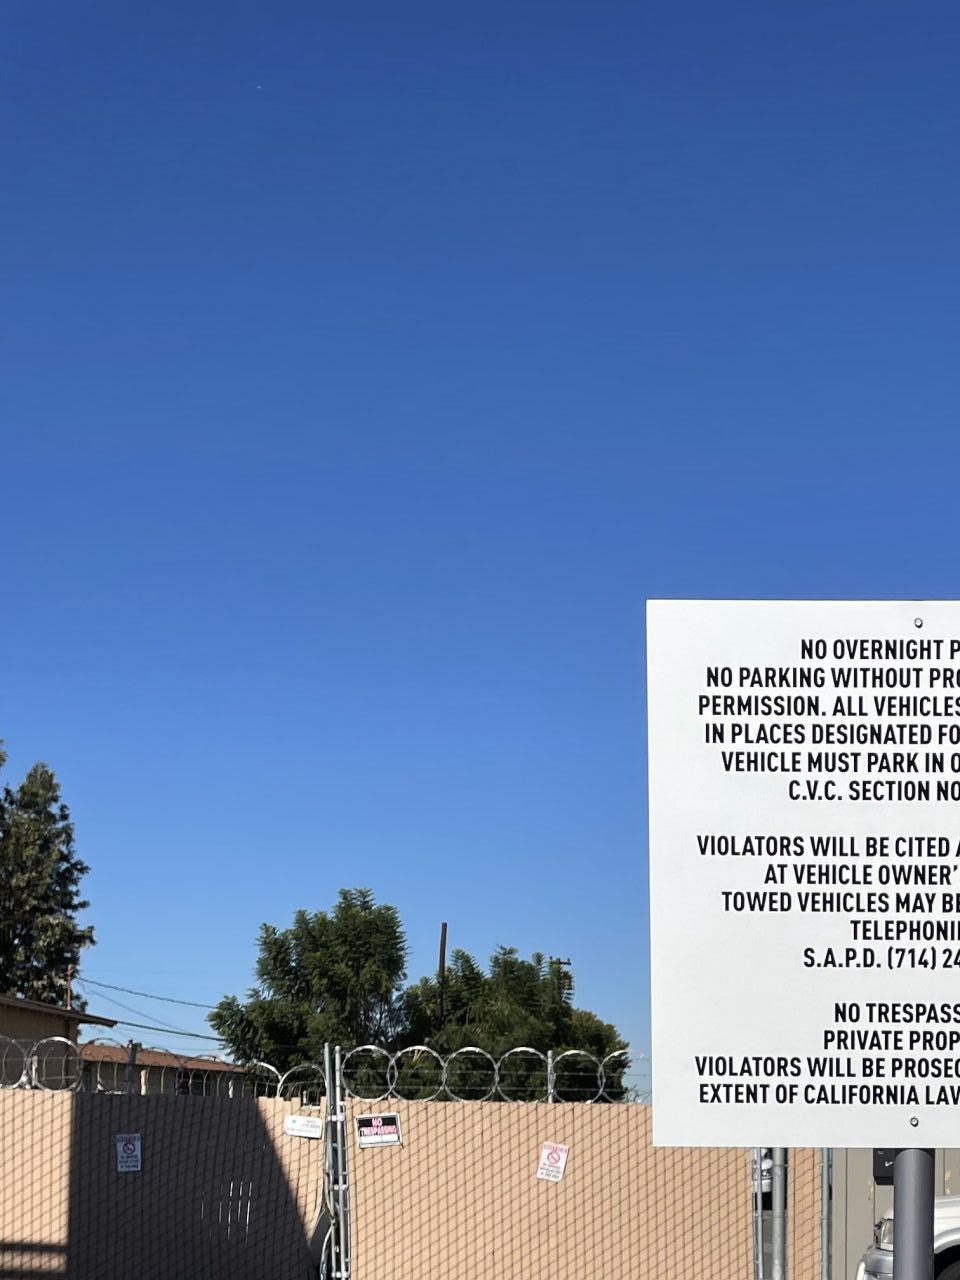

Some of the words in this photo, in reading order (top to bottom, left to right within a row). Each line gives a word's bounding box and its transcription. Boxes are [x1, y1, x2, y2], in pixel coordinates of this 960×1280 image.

[801, 638, 828, 660] NO
[832, 638, 944, 660] OVERNIGHT
[706, 666, 733, 688] NO
[739, 666, 826, 689] PARKING
[830, 667, 924, 689] WITHOUT
[698, 694, 827, 717] PERMISSION.
[832, 695, 869, 717] ALL
[705, 722, 725, 744] IN
[731, 722, 806, 745] PLACES
[811, 723, 932, 745] DESIGNATED
[721, 751, 802, 773] VEHICLE
[807, 751, 862, 773] MUST
[867, 752, 919, 773] PARK
[925, 752, 945, 773] IN
[788, 779, 843, 801] C.V.C.
[848, 780, 930, 802] SECTION
[696, 835, 805, 857] VIOLATORS
[809, 836, 860, 857] WILL
[865, 836, 890, 857] BE
[894, 836, 950, 858] CITED
[763, 863, 788, 885] AT
[792, 863, 873, 885] VEHICLE
[721, 891, 792, 912] TOWED
[796, 891, 890, 913] VEHICLES
[895, 892, 937, 914] MAY
[803, 947, 882, 968] S.A.P.D.
[887, 945, 937, 971] (714)
[834, 1002, 861, 1023] NO
[823, 1029, 904, 1051] PRIVATE
[694, 1055, 802, 1078] VIOLATORS
[806, 1056, 857, 1078] WILL
[862, 1057, 886, 1078] BE
[699, 1083, 771, 1104] EXTENT
[775, 1083, 799, 1104] OF
[803, 1083, 920, 1105] CALIFORNIA
[371, 1117, 383, 1127] NO
